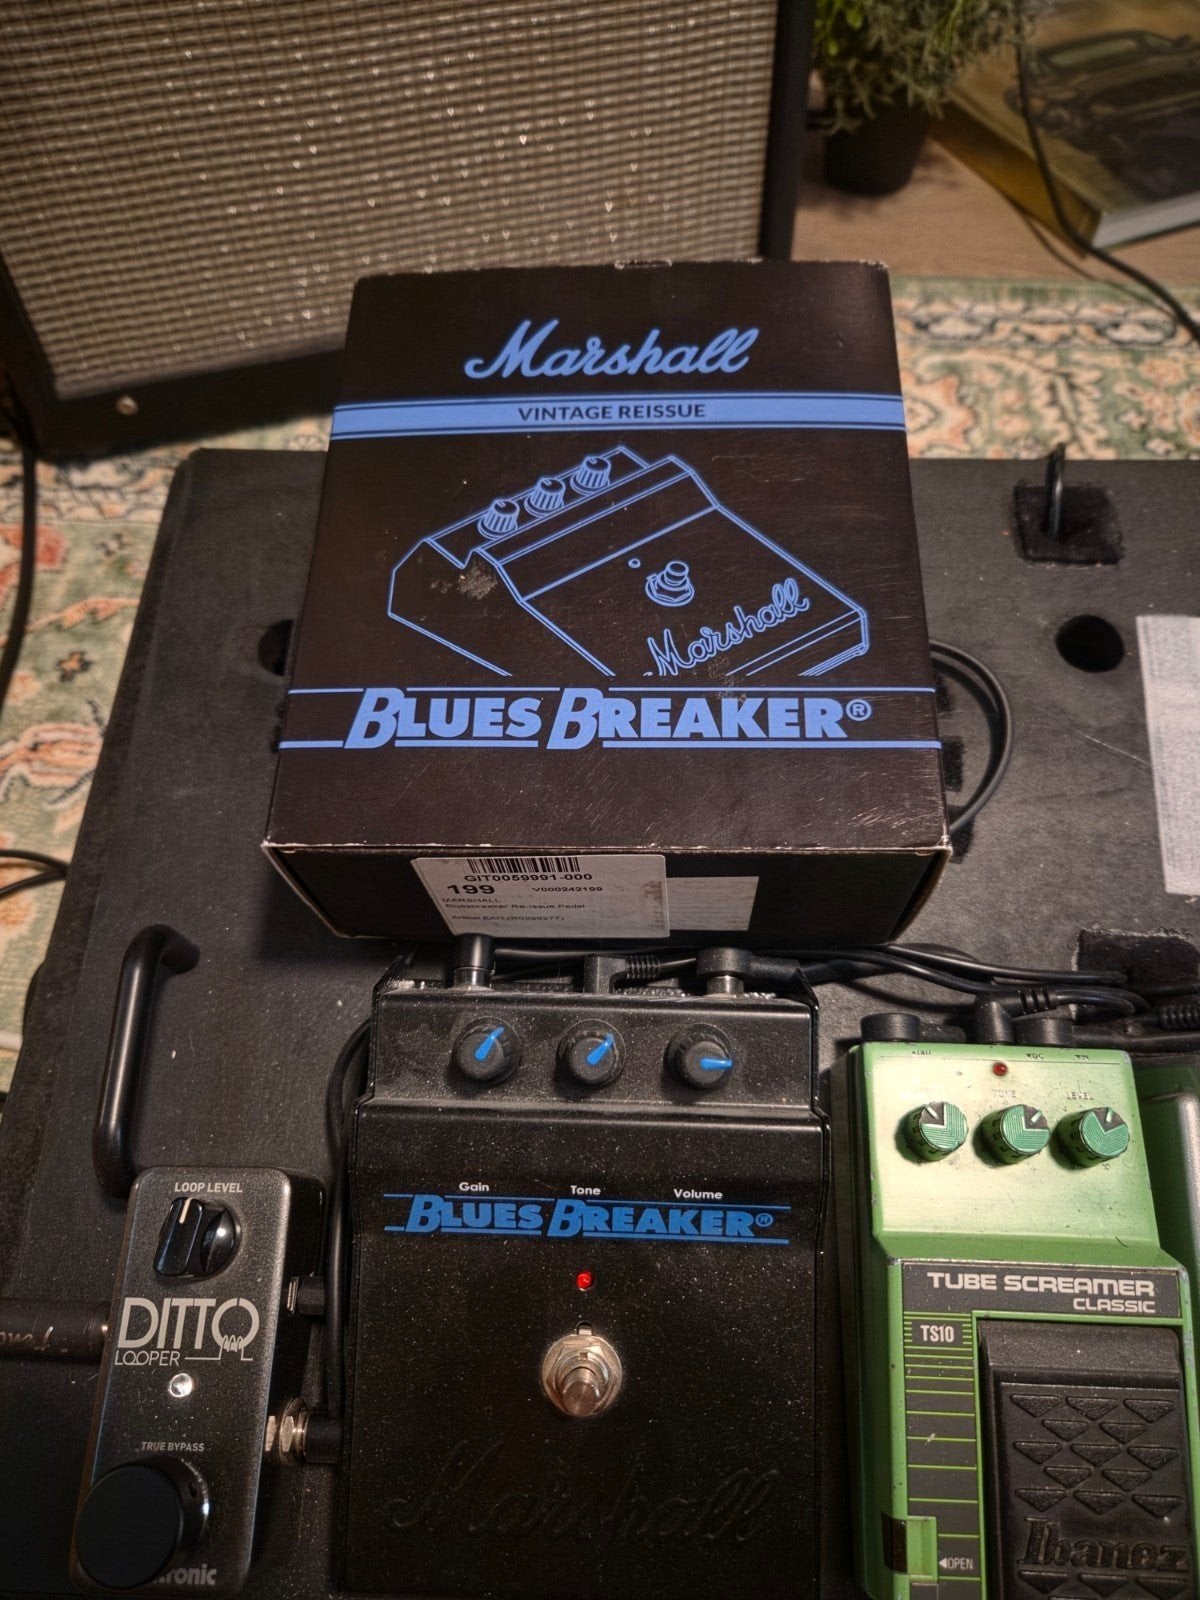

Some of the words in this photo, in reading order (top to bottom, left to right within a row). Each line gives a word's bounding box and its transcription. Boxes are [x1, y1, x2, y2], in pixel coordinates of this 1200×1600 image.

[464, 319, 760, 379] Marshall
[518, 406, 613, 422] VINTAGE
[617, 403, 706, 420] REISSUE
[644, 577, 810, 677] Marshall
[464, 873, 593, 882] GIT0059991-000
[446, 885, 495, 895] 199
[1064, 1090, 1095, 1100] LEVEL
[173, 1182, 205, 1193] LOOP
[206, 1182, 244, 1194] LEVEL
[458, 1181, 490, 1193] Gain
[570, 1185, 602, 1195] Tone
[673, 1188, 724, 1200] Volume
[926, 1271, 998, 1291] TUBE
[1003, 1273, 1156, 1297] SCREAMER
[1072, 1297, 1156, 1314] CLASSIC
[117, 1297, 260, 1352] DITTO
[920, 1324, 956, 1343] TS10
[114, 1350, 181, 1366] LOOPER
[141, 1441, 166, 1451] TRUE
[167, 1443, 205, 1452] BYPASS
[1017, 1516, 1189, 1571] Ibanez
[947, 1557, 974, 1570] OPEN
